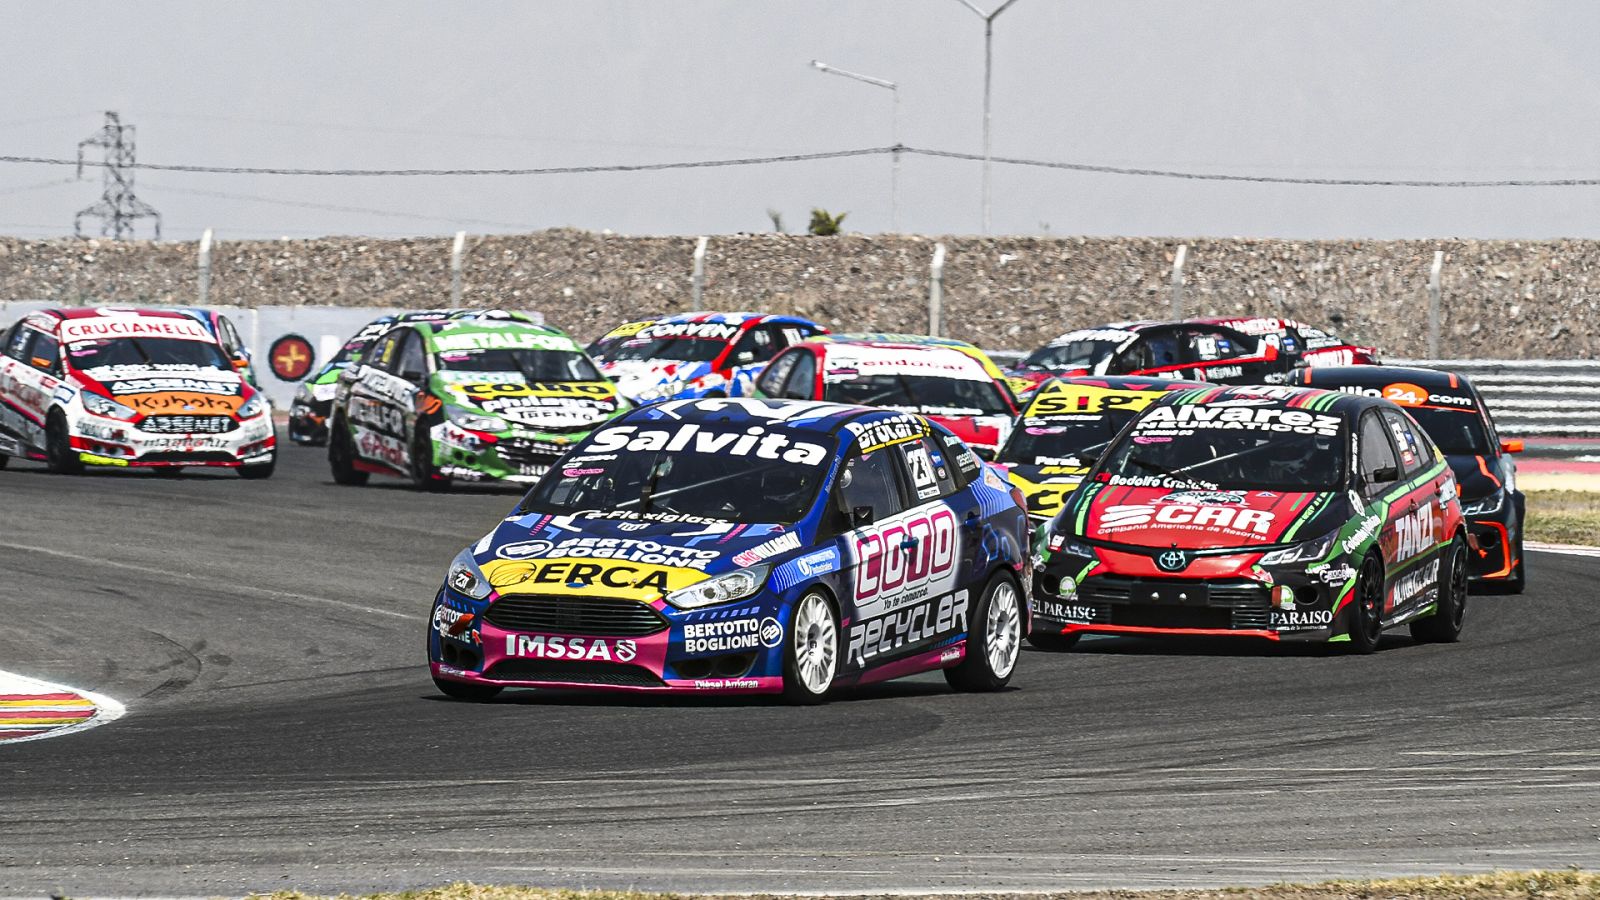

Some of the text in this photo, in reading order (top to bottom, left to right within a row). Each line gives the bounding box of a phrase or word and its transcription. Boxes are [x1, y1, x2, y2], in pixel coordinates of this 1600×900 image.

[67, 323, 207, 337] CRUCIANELLI
[635, 323, 737, 339] CORVEN
[1138, 404, 1342, 430] Alvarez
[583, 423, 828, 466] Salvita
[1150, 522, 1204, 532] Americana
[1395, 502, 1435, 563] TANZI
[546, 547, 713, 571] BOGLIONE
[554, 538, 721, 559] BERTOTTO
[855, 509, 955, 600] COTO
[534, 562, 668, 590] ERCA
[683, 618, 759, 639] BERTOTTO
[1269, 610, 1334, 625] PARAISO
[505, 634, 611, 661] IMSSA
[685, 633, 759, 653] BOGLIONE
